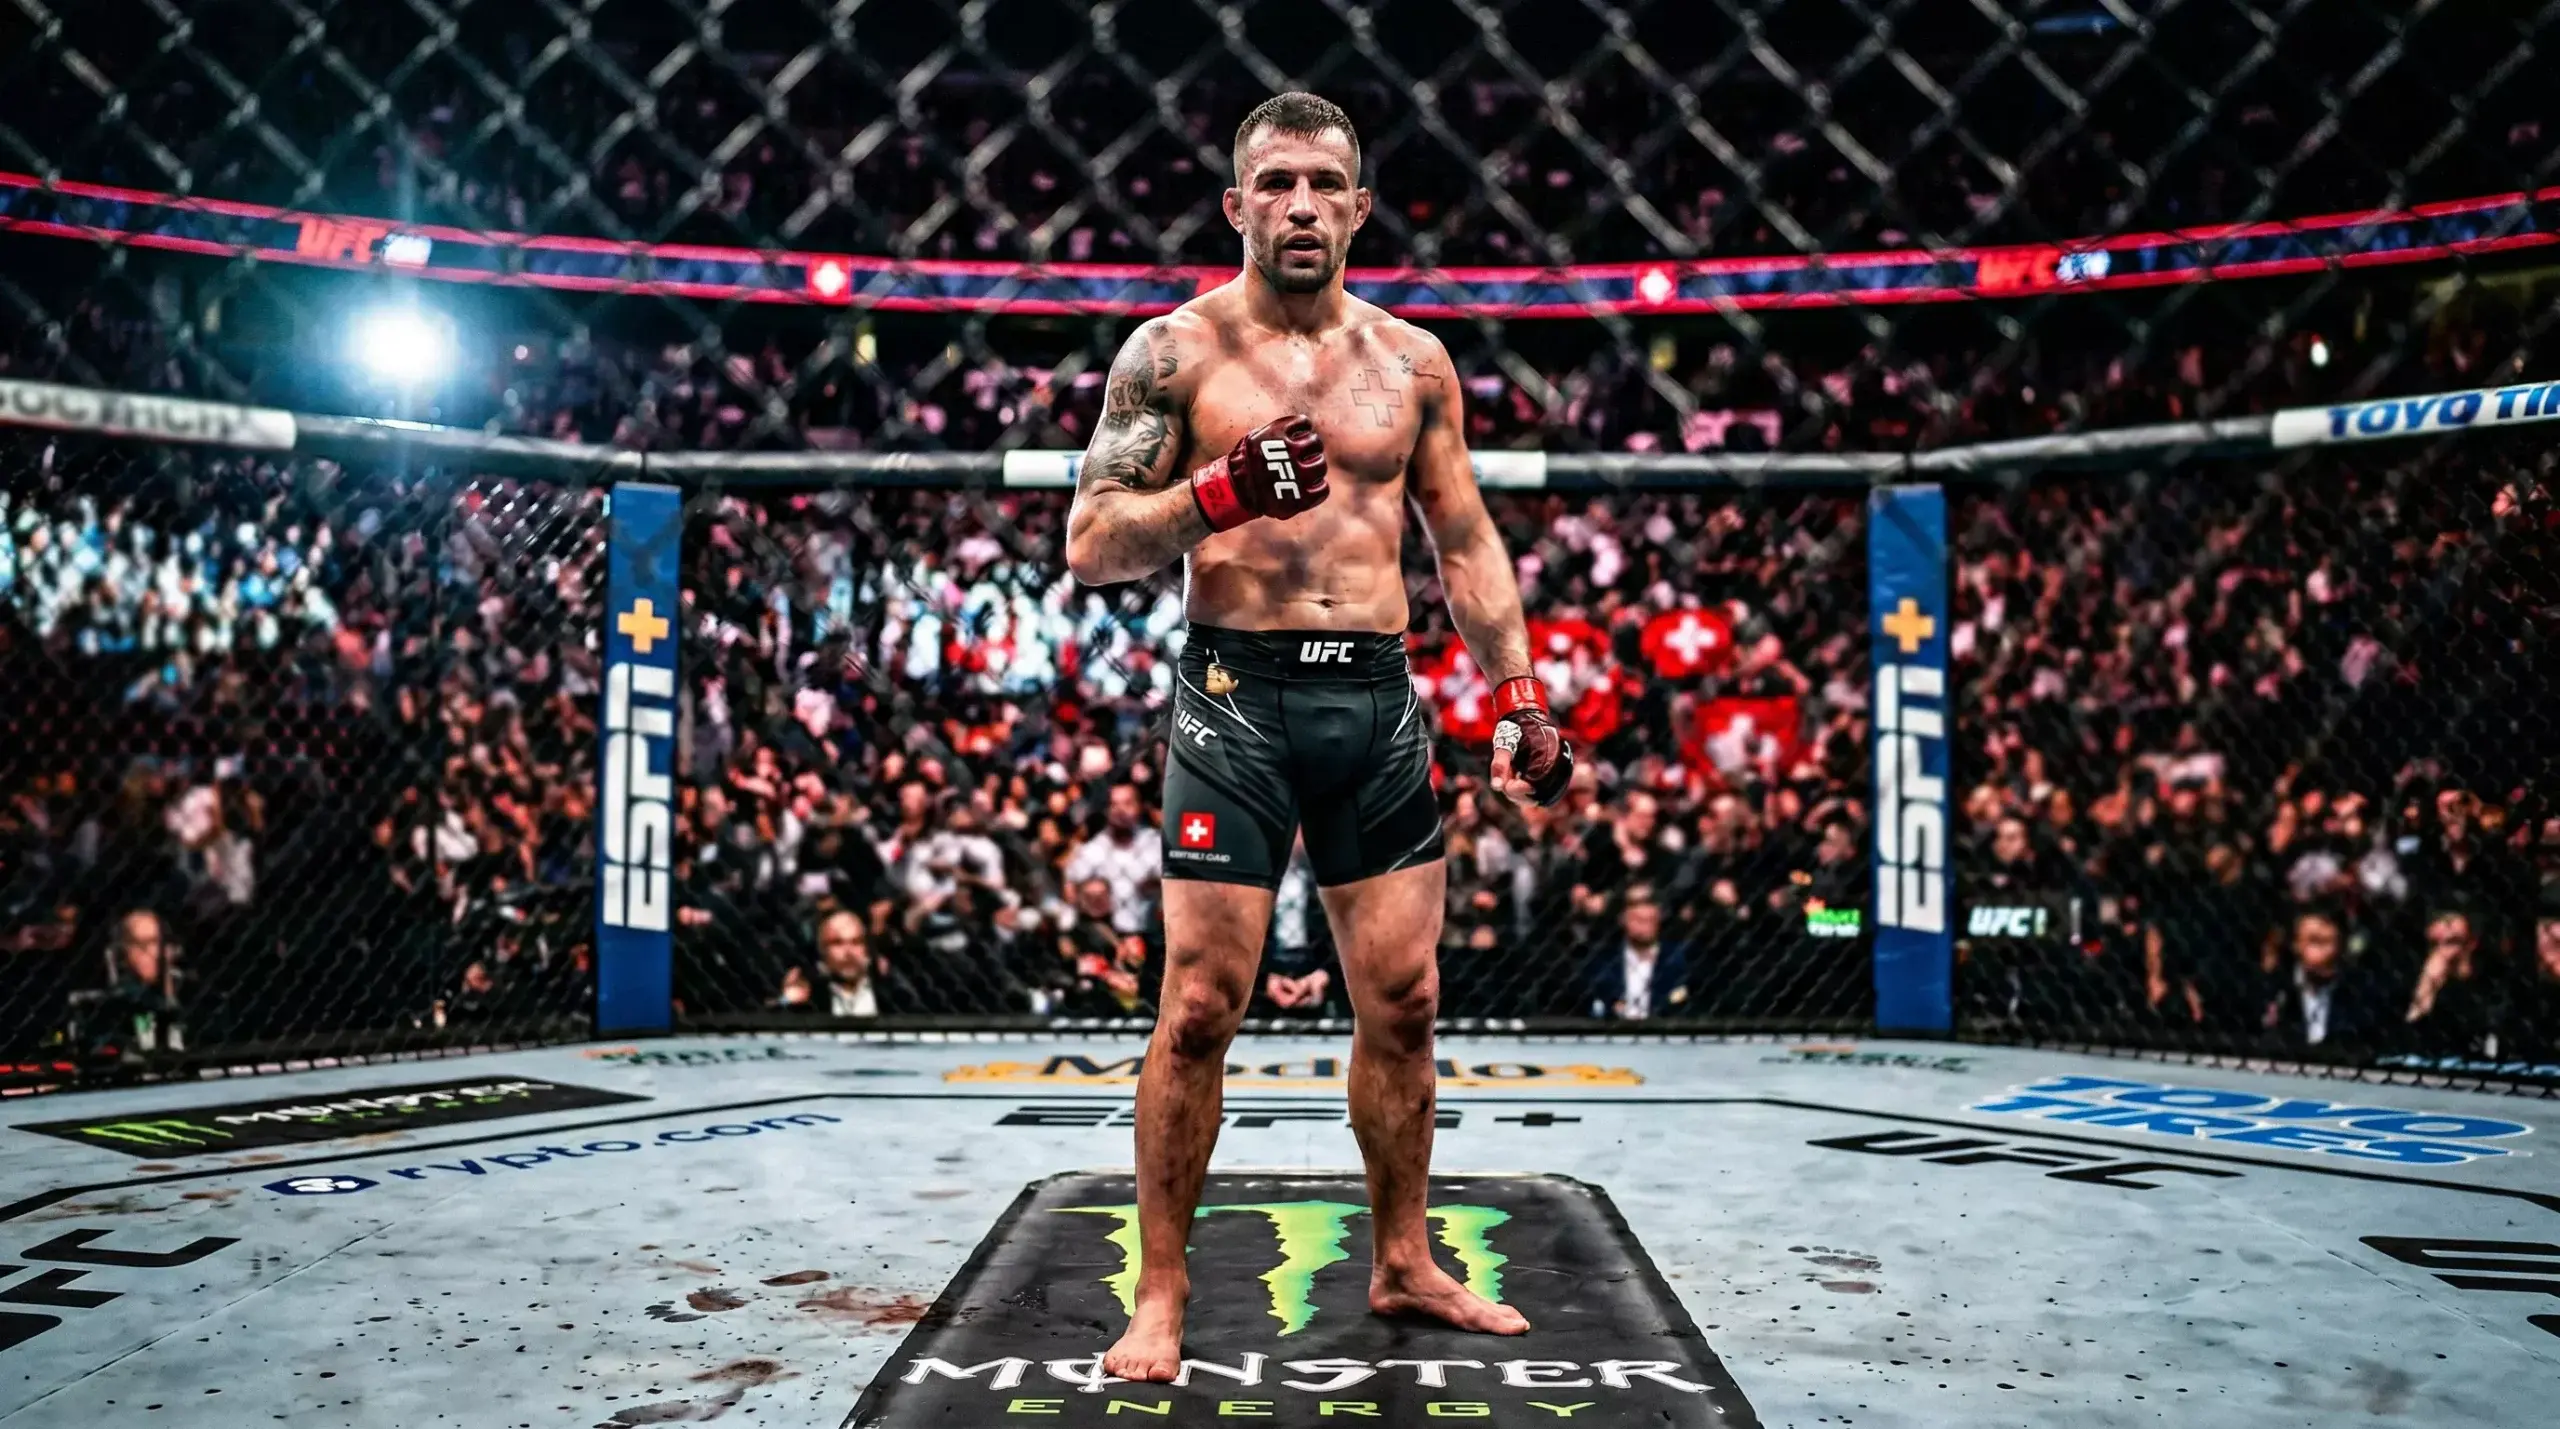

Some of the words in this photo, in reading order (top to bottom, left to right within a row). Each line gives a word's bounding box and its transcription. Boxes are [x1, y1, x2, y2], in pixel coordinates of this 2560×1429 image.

[2327, 391, 2484, 438] TOYO
[1260, 439, 1301, 500] UFC
[1299, 641, 1354, 663] UFC
[1177, 709, 1218, 747] UFC
[1973, 1096, 2516, 1166] TIRES
[2018, 1075, 2527, 1138] TOYO
[1805, 1130, 2246, 1190] UFC
[1006, 1399, 1597, 1418] ENERGY
